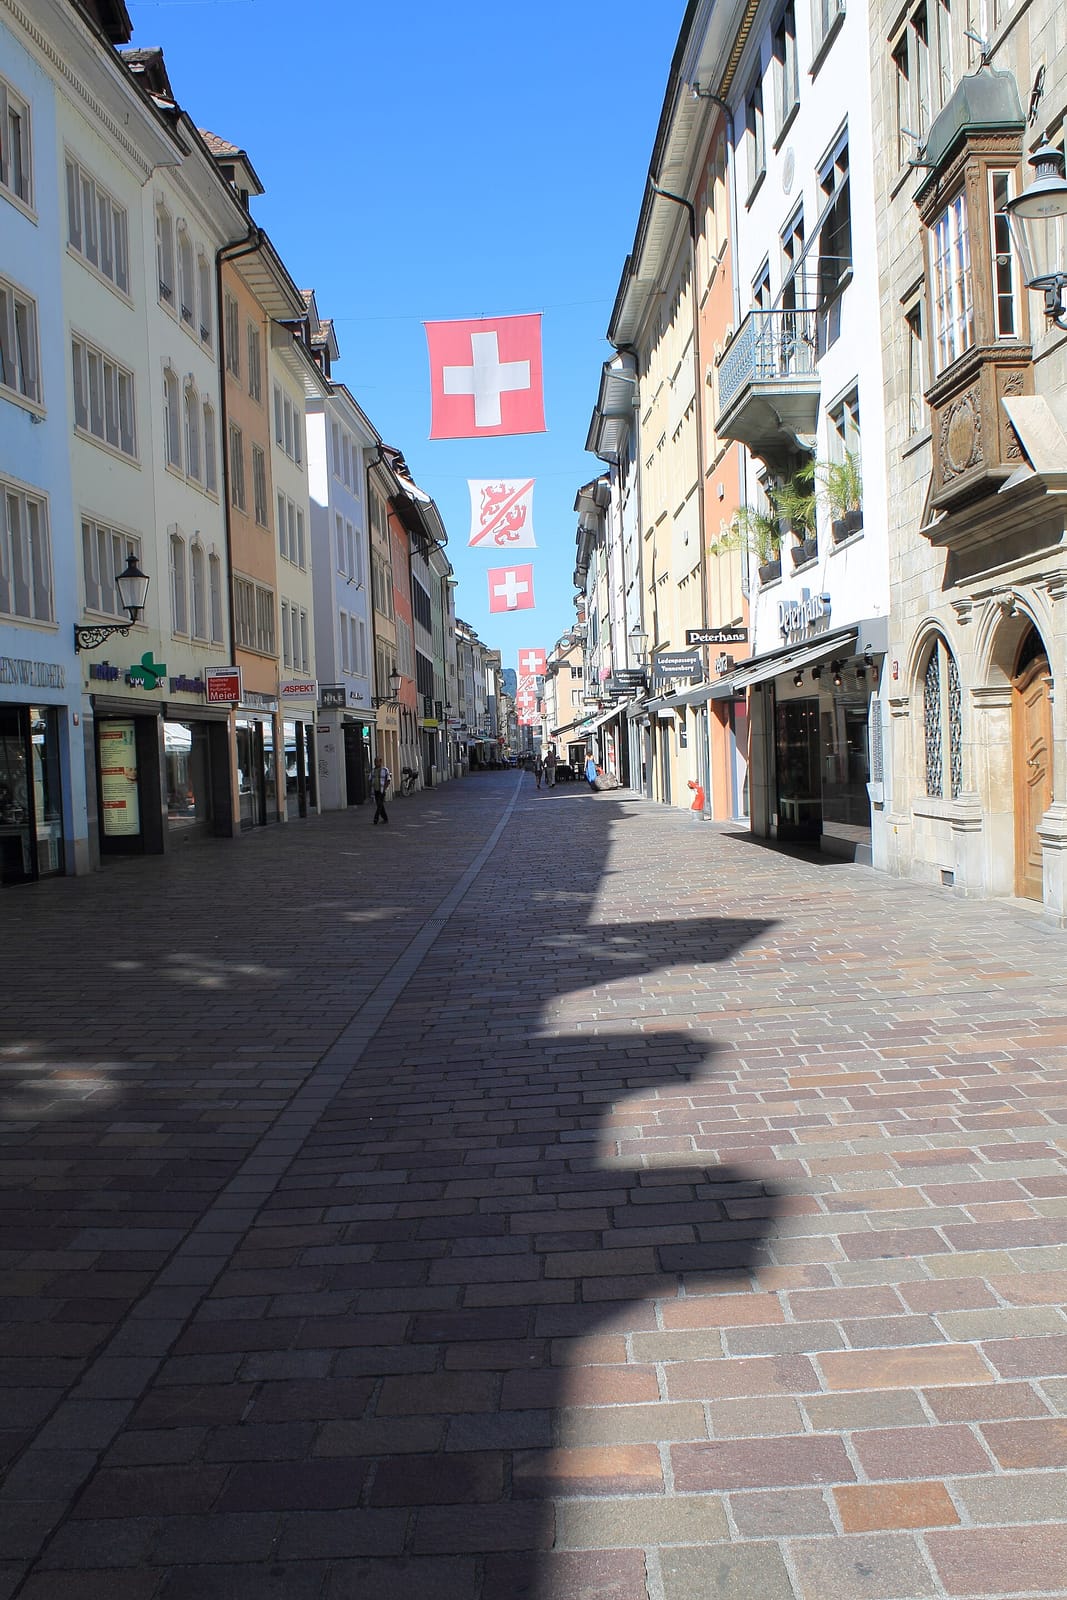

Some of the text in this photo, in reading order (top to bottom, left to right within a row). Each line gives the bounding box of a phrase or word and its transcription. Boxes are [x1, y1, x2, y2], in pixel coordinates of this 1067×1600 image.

[777, 588, 831, 634] Peterhans
[689, 631, 746, 643] Peterhans
[657, 657, 697, 665] Ladenpassage
[282, 684, 316, 693] ASPEKT
[210, 691, 237, 700] Meier
[323, 694, 344, 703] NILE
